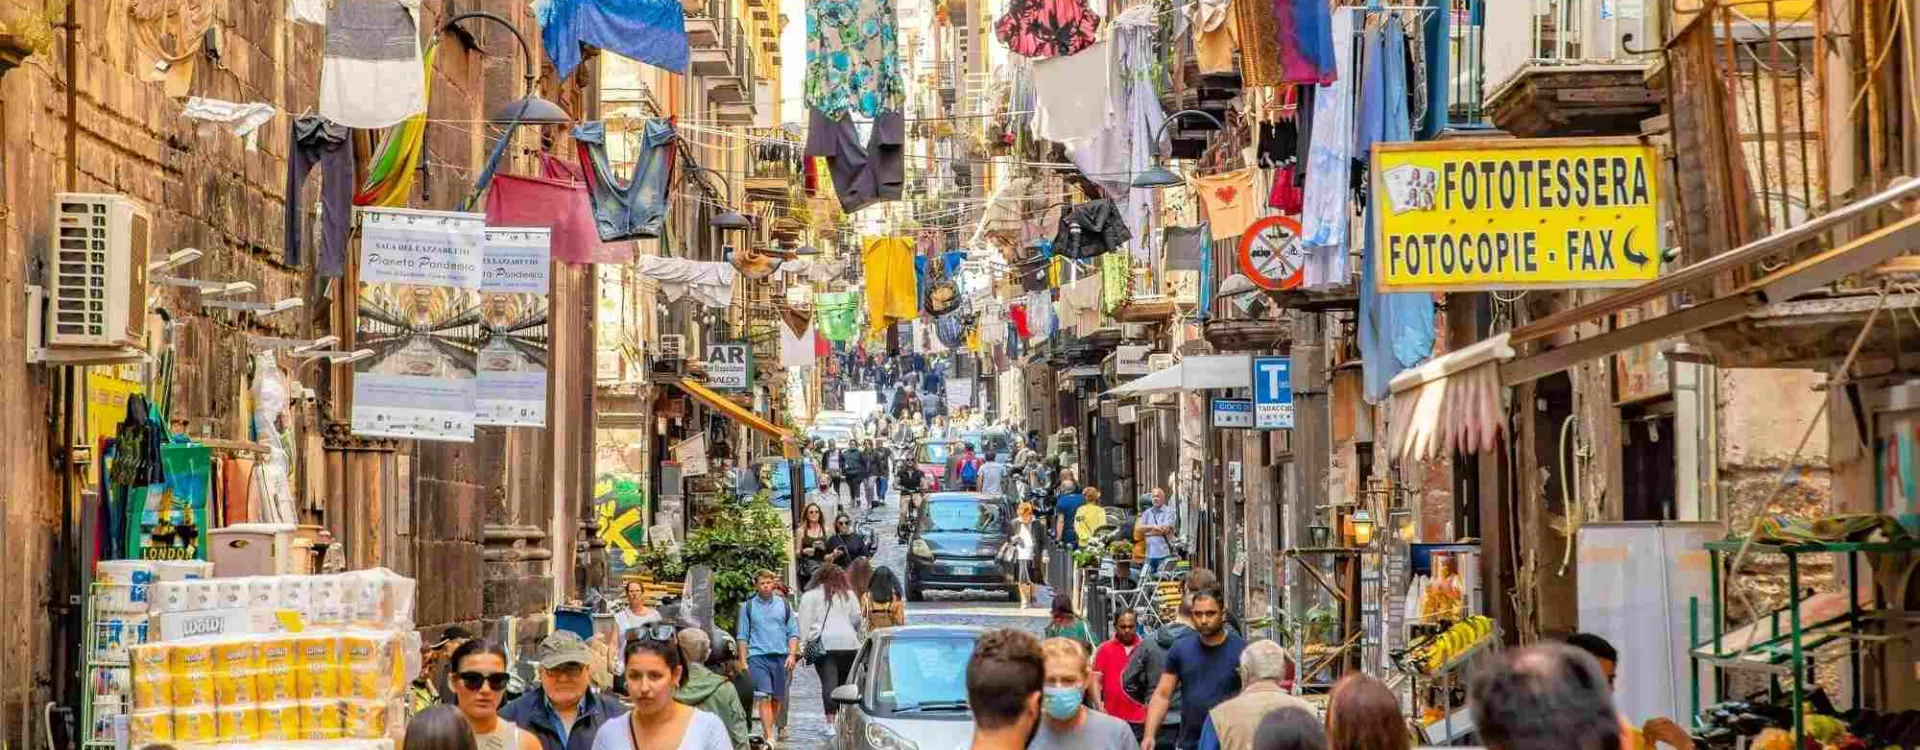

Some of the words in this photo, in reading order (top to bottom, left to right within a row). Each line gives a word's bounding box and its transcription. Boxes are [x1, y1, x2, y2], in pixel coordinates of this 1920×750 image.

[1443, 156, 1650, 211] FOTOTESSERA
[1389, 231, 1538, 276] FOTOCOPIE
[1566, 229, 1616, 270] FAX
[368, 253, 415, 268] Pianeta
[418, 256, 476, 273] Pandemia
[496, 267, 544, 279] Pandemia
[709, 347, 744, 363] AR
[1260, 364, 1287, 400] T
[143, 548, 194, 561] LONDON
